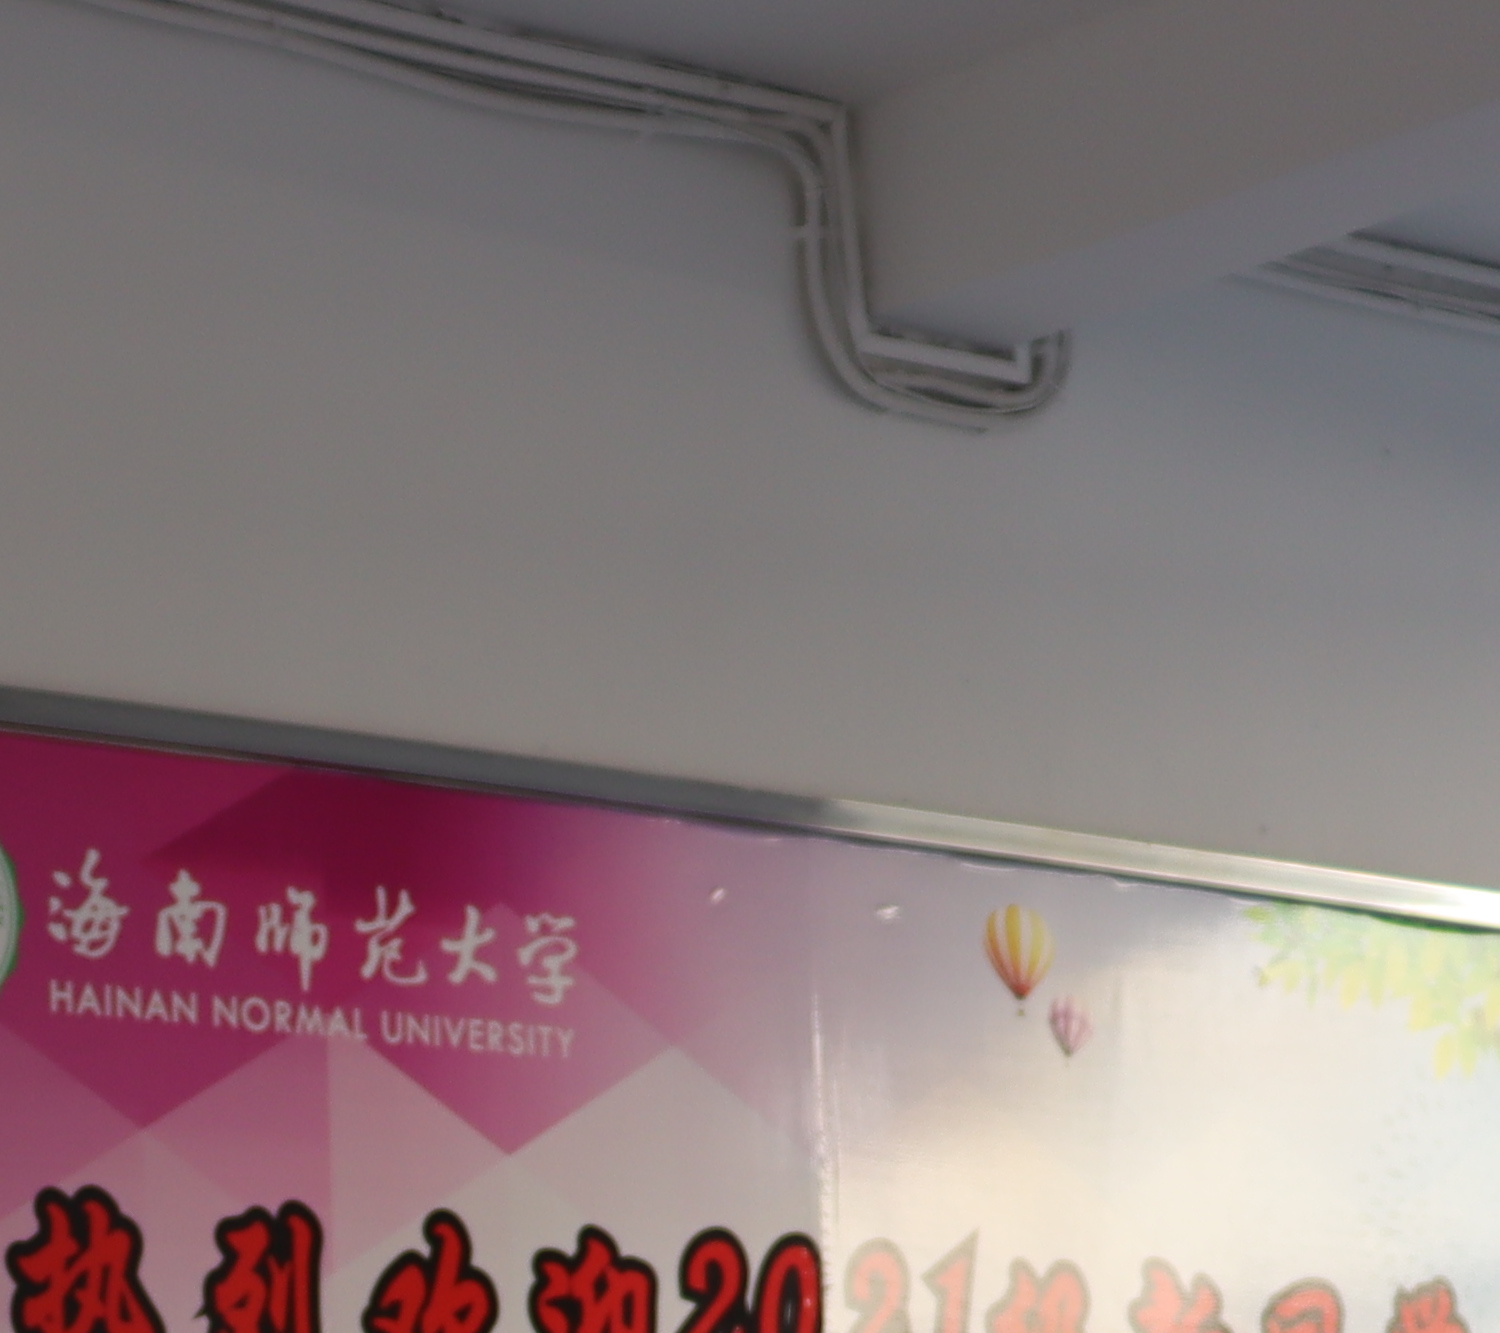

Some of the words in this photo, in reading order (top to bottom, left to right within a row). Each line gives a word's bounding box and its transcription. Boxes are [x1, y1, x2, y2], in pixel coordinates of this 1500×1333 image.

[49, 979, 198, 1024] HAINAN
[213, 994, 367, 1040] NORMAL
[381, 1009, 576, 1059] UNIVERSITY
